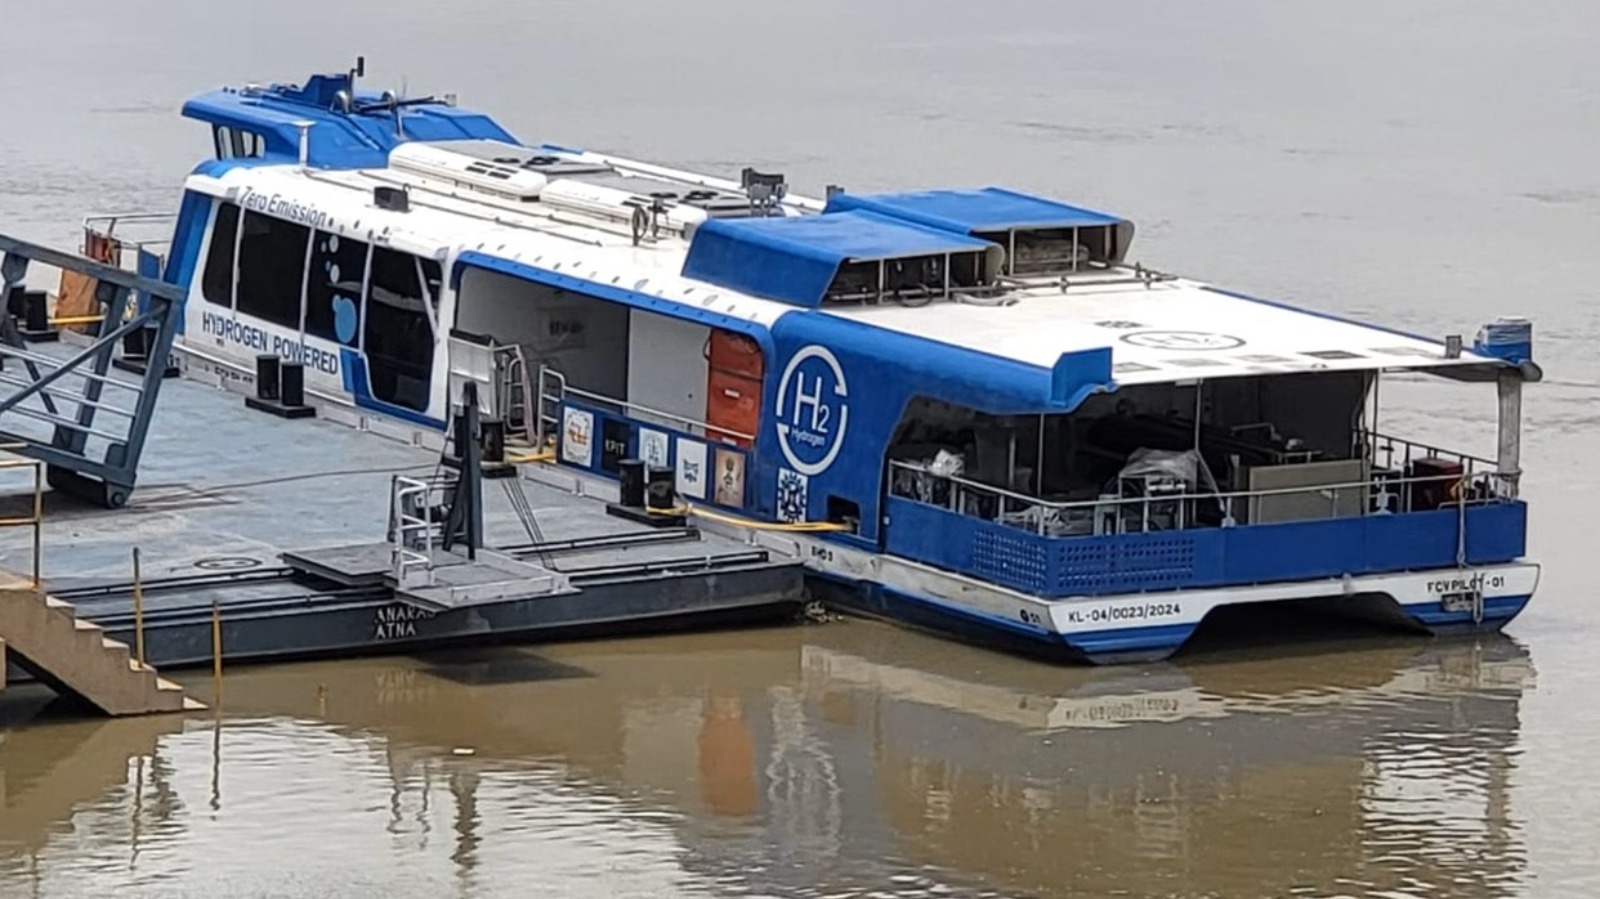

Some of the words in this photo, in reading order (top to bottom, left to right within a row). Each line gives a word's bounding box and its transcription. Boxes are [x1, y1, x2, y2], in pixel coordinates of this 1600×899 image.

[240, 186, 268, 210] Zero
[268, 194, 327, 227] Emission
[202, 311, 268, 352] HYDROGEN
[273, 335, 339, 375] POWERED
[1068, 603, 1181, 623] KL-04/0023/2024
